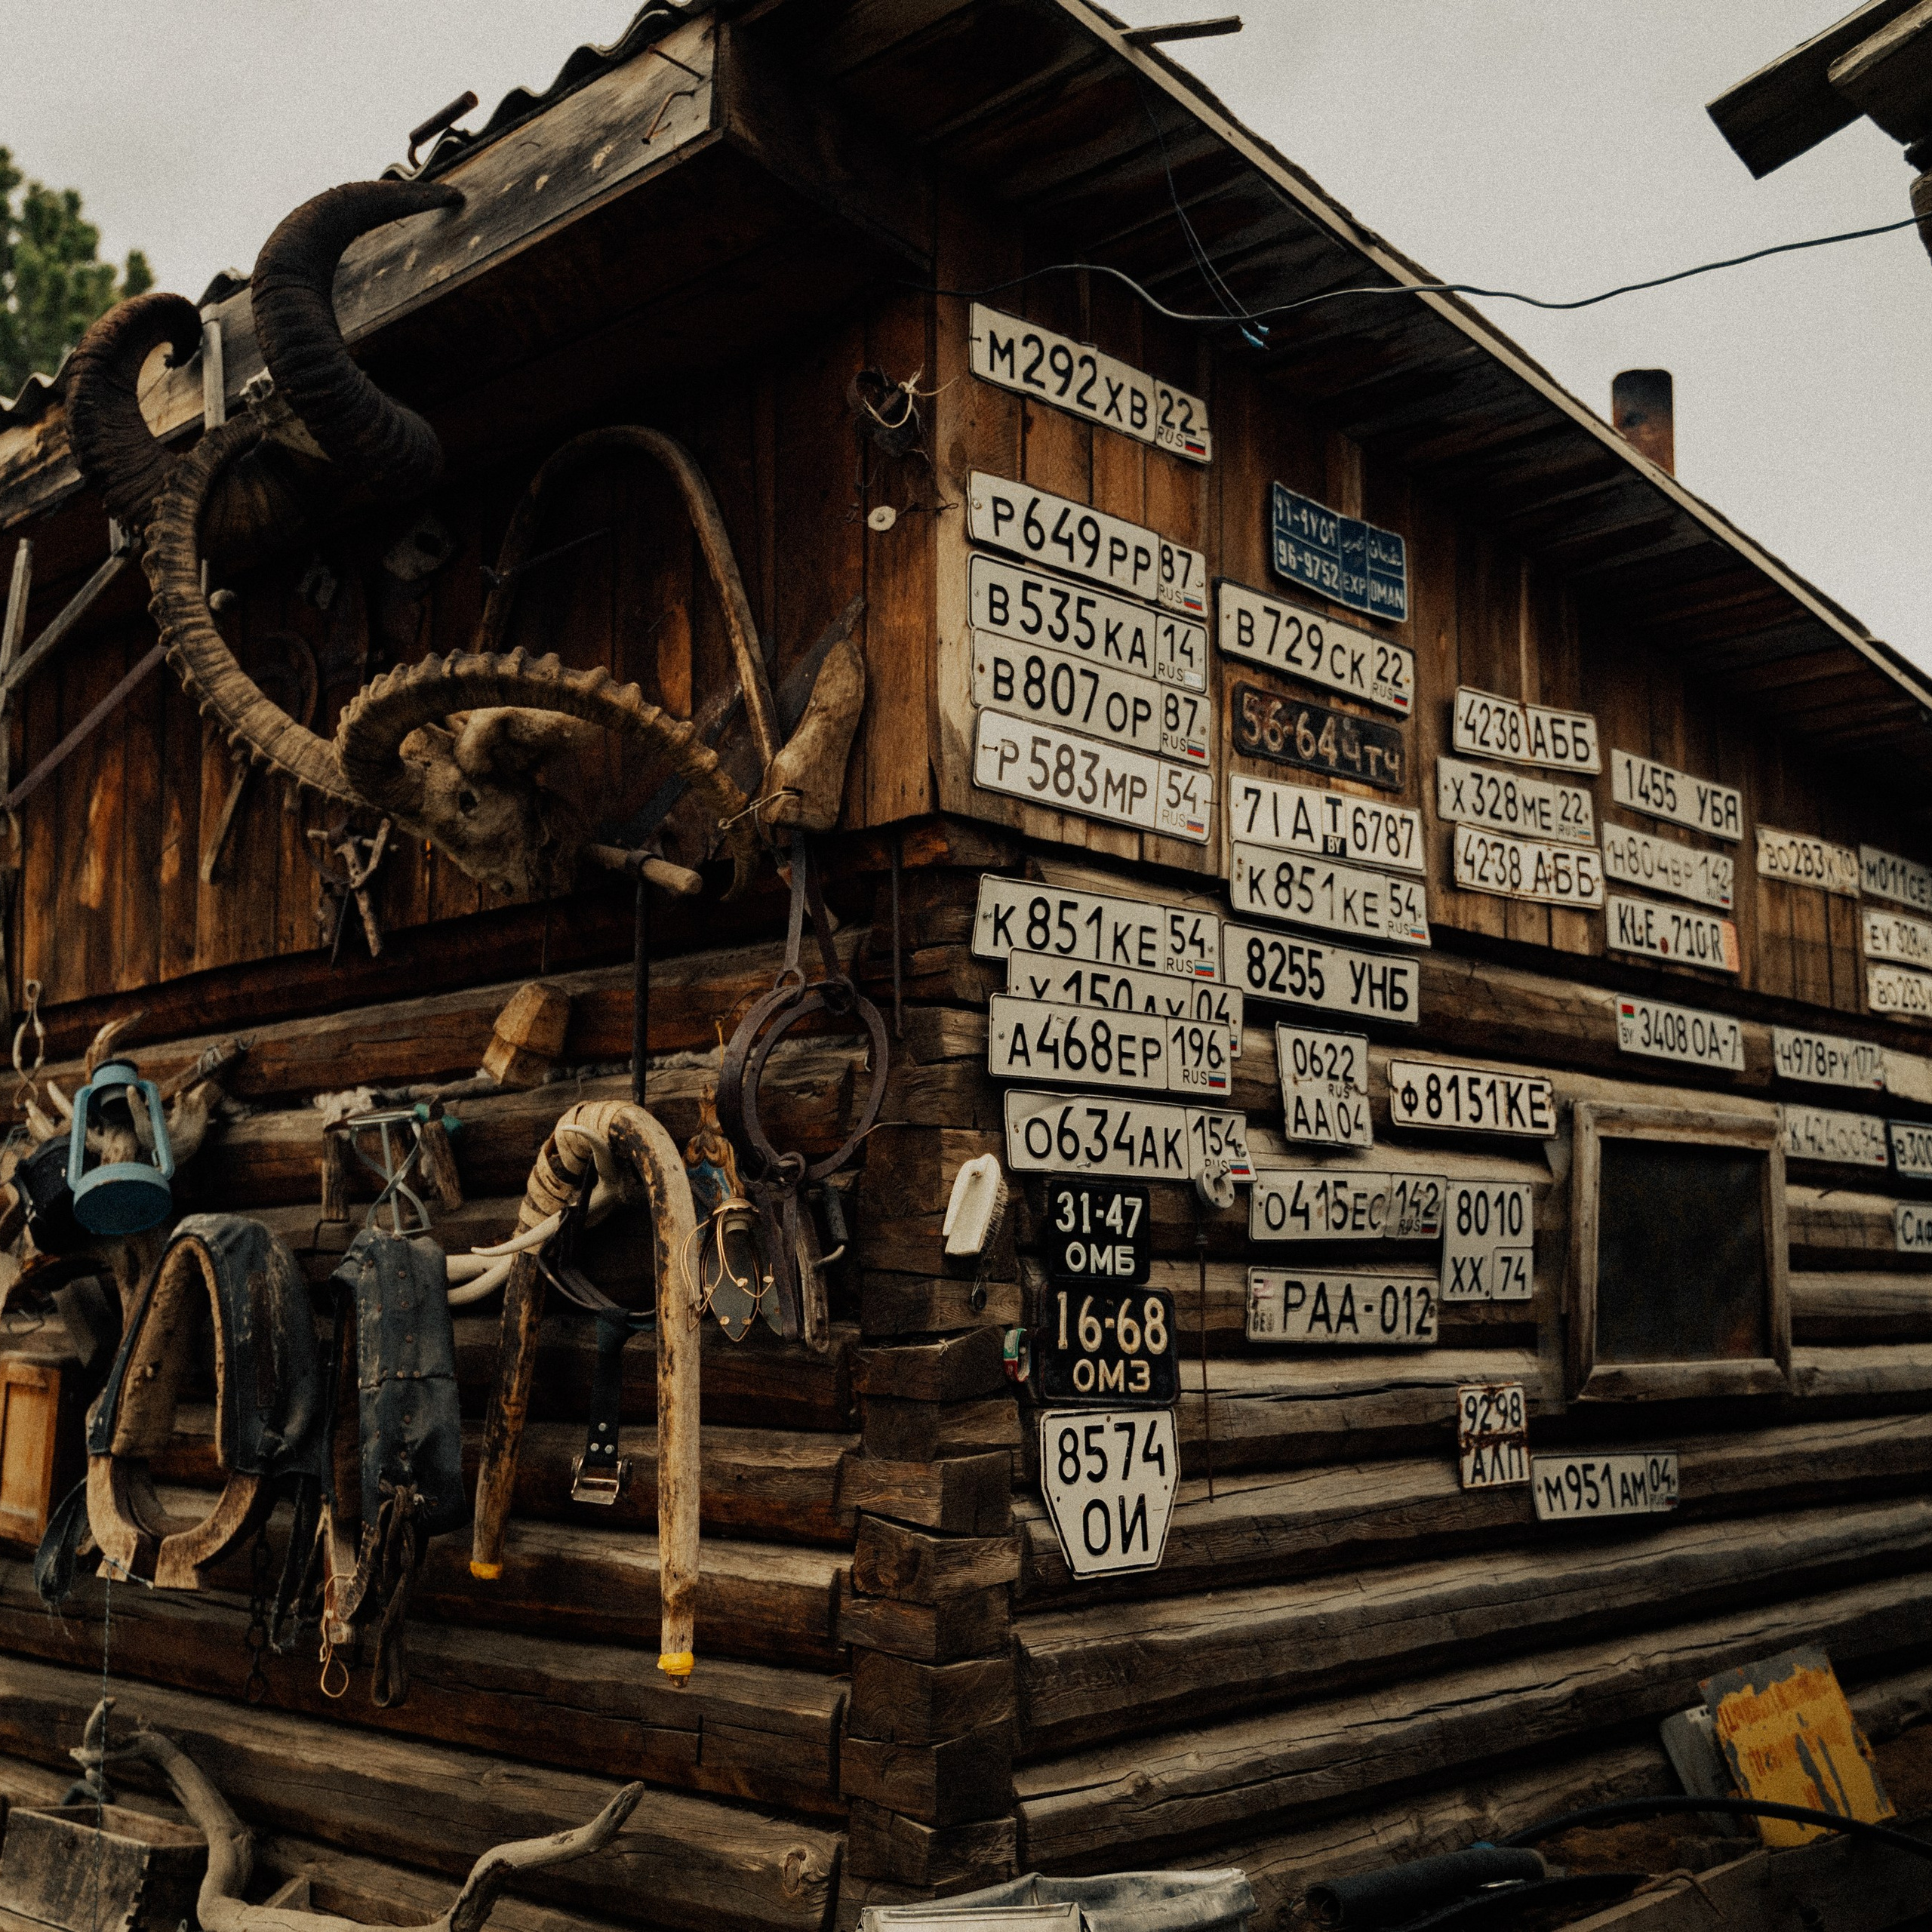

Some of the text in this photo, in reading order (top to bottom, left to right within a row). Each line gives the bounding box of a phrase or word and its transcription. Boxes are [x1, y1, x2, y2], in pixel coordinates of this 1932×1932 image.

[989, 330, 1196, 436] М292ХВ 22
[1156, 425, 1183, 448] RUS
[992, 495, 1192, 589] Р649РР 87
[1159, 583, 1183, 604] RUS
[1278, 539, 1404, 610] 96-9752 EXP OMAN
[989, 580, 1194, 669] В535КА 14
[1237, 605, 1403, 689] В729СК 22
[993, 655, 1198, 737] В807ОР 87
[1158, 661, 1184, 681] RUS
[1371, 681, 1394, 701] RUS
[1161, 732, 1186, 752] RUS
[1463, 699, 1590, 763] 4238 АББ
[998, 735, 1197, 816] Р583МР 54
[1625, 758, 1677, 813] 1455
[1161, 808, 1186, 828] RUS
[1451, 771, 1583, 832] Х328МЕ 22
[1327, 837, 1342, 854] BY
[1352, 806, 1414, 860] 6787
[1463, 834, 1595, 897] 4238 АББ
[1249, 861, 1417, 929] К851КЕ 54
[992, 896, 1205, 968] К851КЕ 54
[1387, 920, 1410, 935] RUS
[1618, 903, 1657, 949] KLE
[1166, 957, 1194, 973] RUS
[1246, 937, 1409, 1012] 8255 УНБ
[1008, 1014, 1223, 1078] А468ЕР 196
[1639, 1007, 1688, 1053] 3408
[1183, 1069, 1208, 1085] RUS
[1293, 1038, 1355, 1083] 0622
[1294, 1095, 1332, 1137] АА
[1328, 1083, 1350, 1099] RUS
[1024, 1106, 1241, 1170] О634АК 154
[1055, 1190, 1143, 1238] 31-47
[1395, 1180, 1439, 1218] 142
[1456, 1189, 1523, 1237] 8010
[1065, 1241, 1136, 1275] ОМБ
[1449, 1255, 1526, 1294] ХХ 74
[1057, 1291, 1168, 1355] 16-68
[1282, 1279, 1434, 1337] PAA-012
[1072, 1358, 1151, 1393] ОМЗ
[1464, 1391, 1522, 1432] 9298
[1057, 1419, 1166, 1486] 8574
[1543, 1457, 1671, 1512] М951АМ 04
[1082, 1493, 1149, 1557] ОИ
